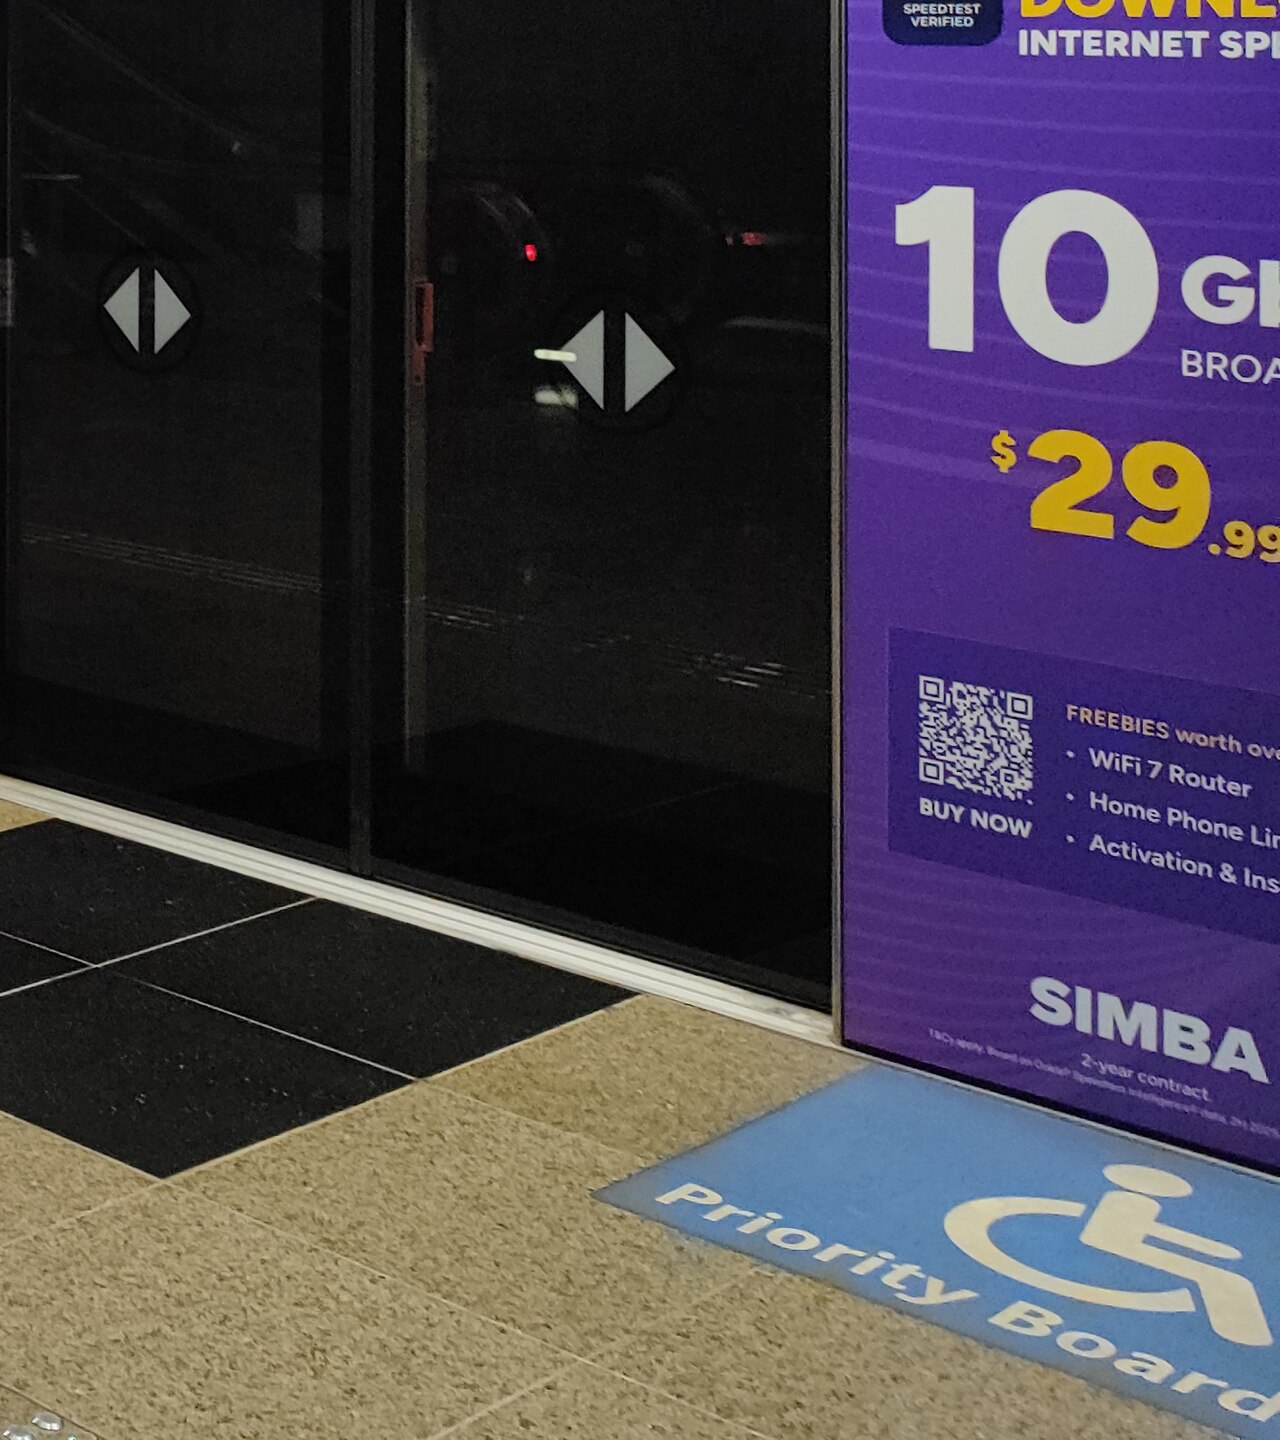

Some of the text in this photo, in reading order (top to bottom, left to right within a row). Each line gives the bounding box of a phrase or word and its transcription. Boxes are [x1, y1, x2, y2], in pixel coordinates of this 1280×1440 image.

[903, 3, 982, 16] SPEEDTEST
[910, 15, 975, 28] VERIFIED
[1018, 29, 1209, 59] INTERNET
[895, 185, 1160, 366] 10
[1066, 704, 1169, 740] FREEBIES
[1174, 724, 1242, 754] worth
[1089, 747, 1253, 799] WiFi 7 Router
[919, 797, 1033, 839] BUY NOW
[1090, 791, 1161, 824] Home
[1167, 807, 1244, 841] Phone
[1089, 834, 1213, 879] Activation
[1219, 862, 1238, 885] &
[1028, 976, 1271, 1085] SIMBA
[1081, 1053, 1134, 1079] 2-year
[655, 1182, 979, 1307] Priority
